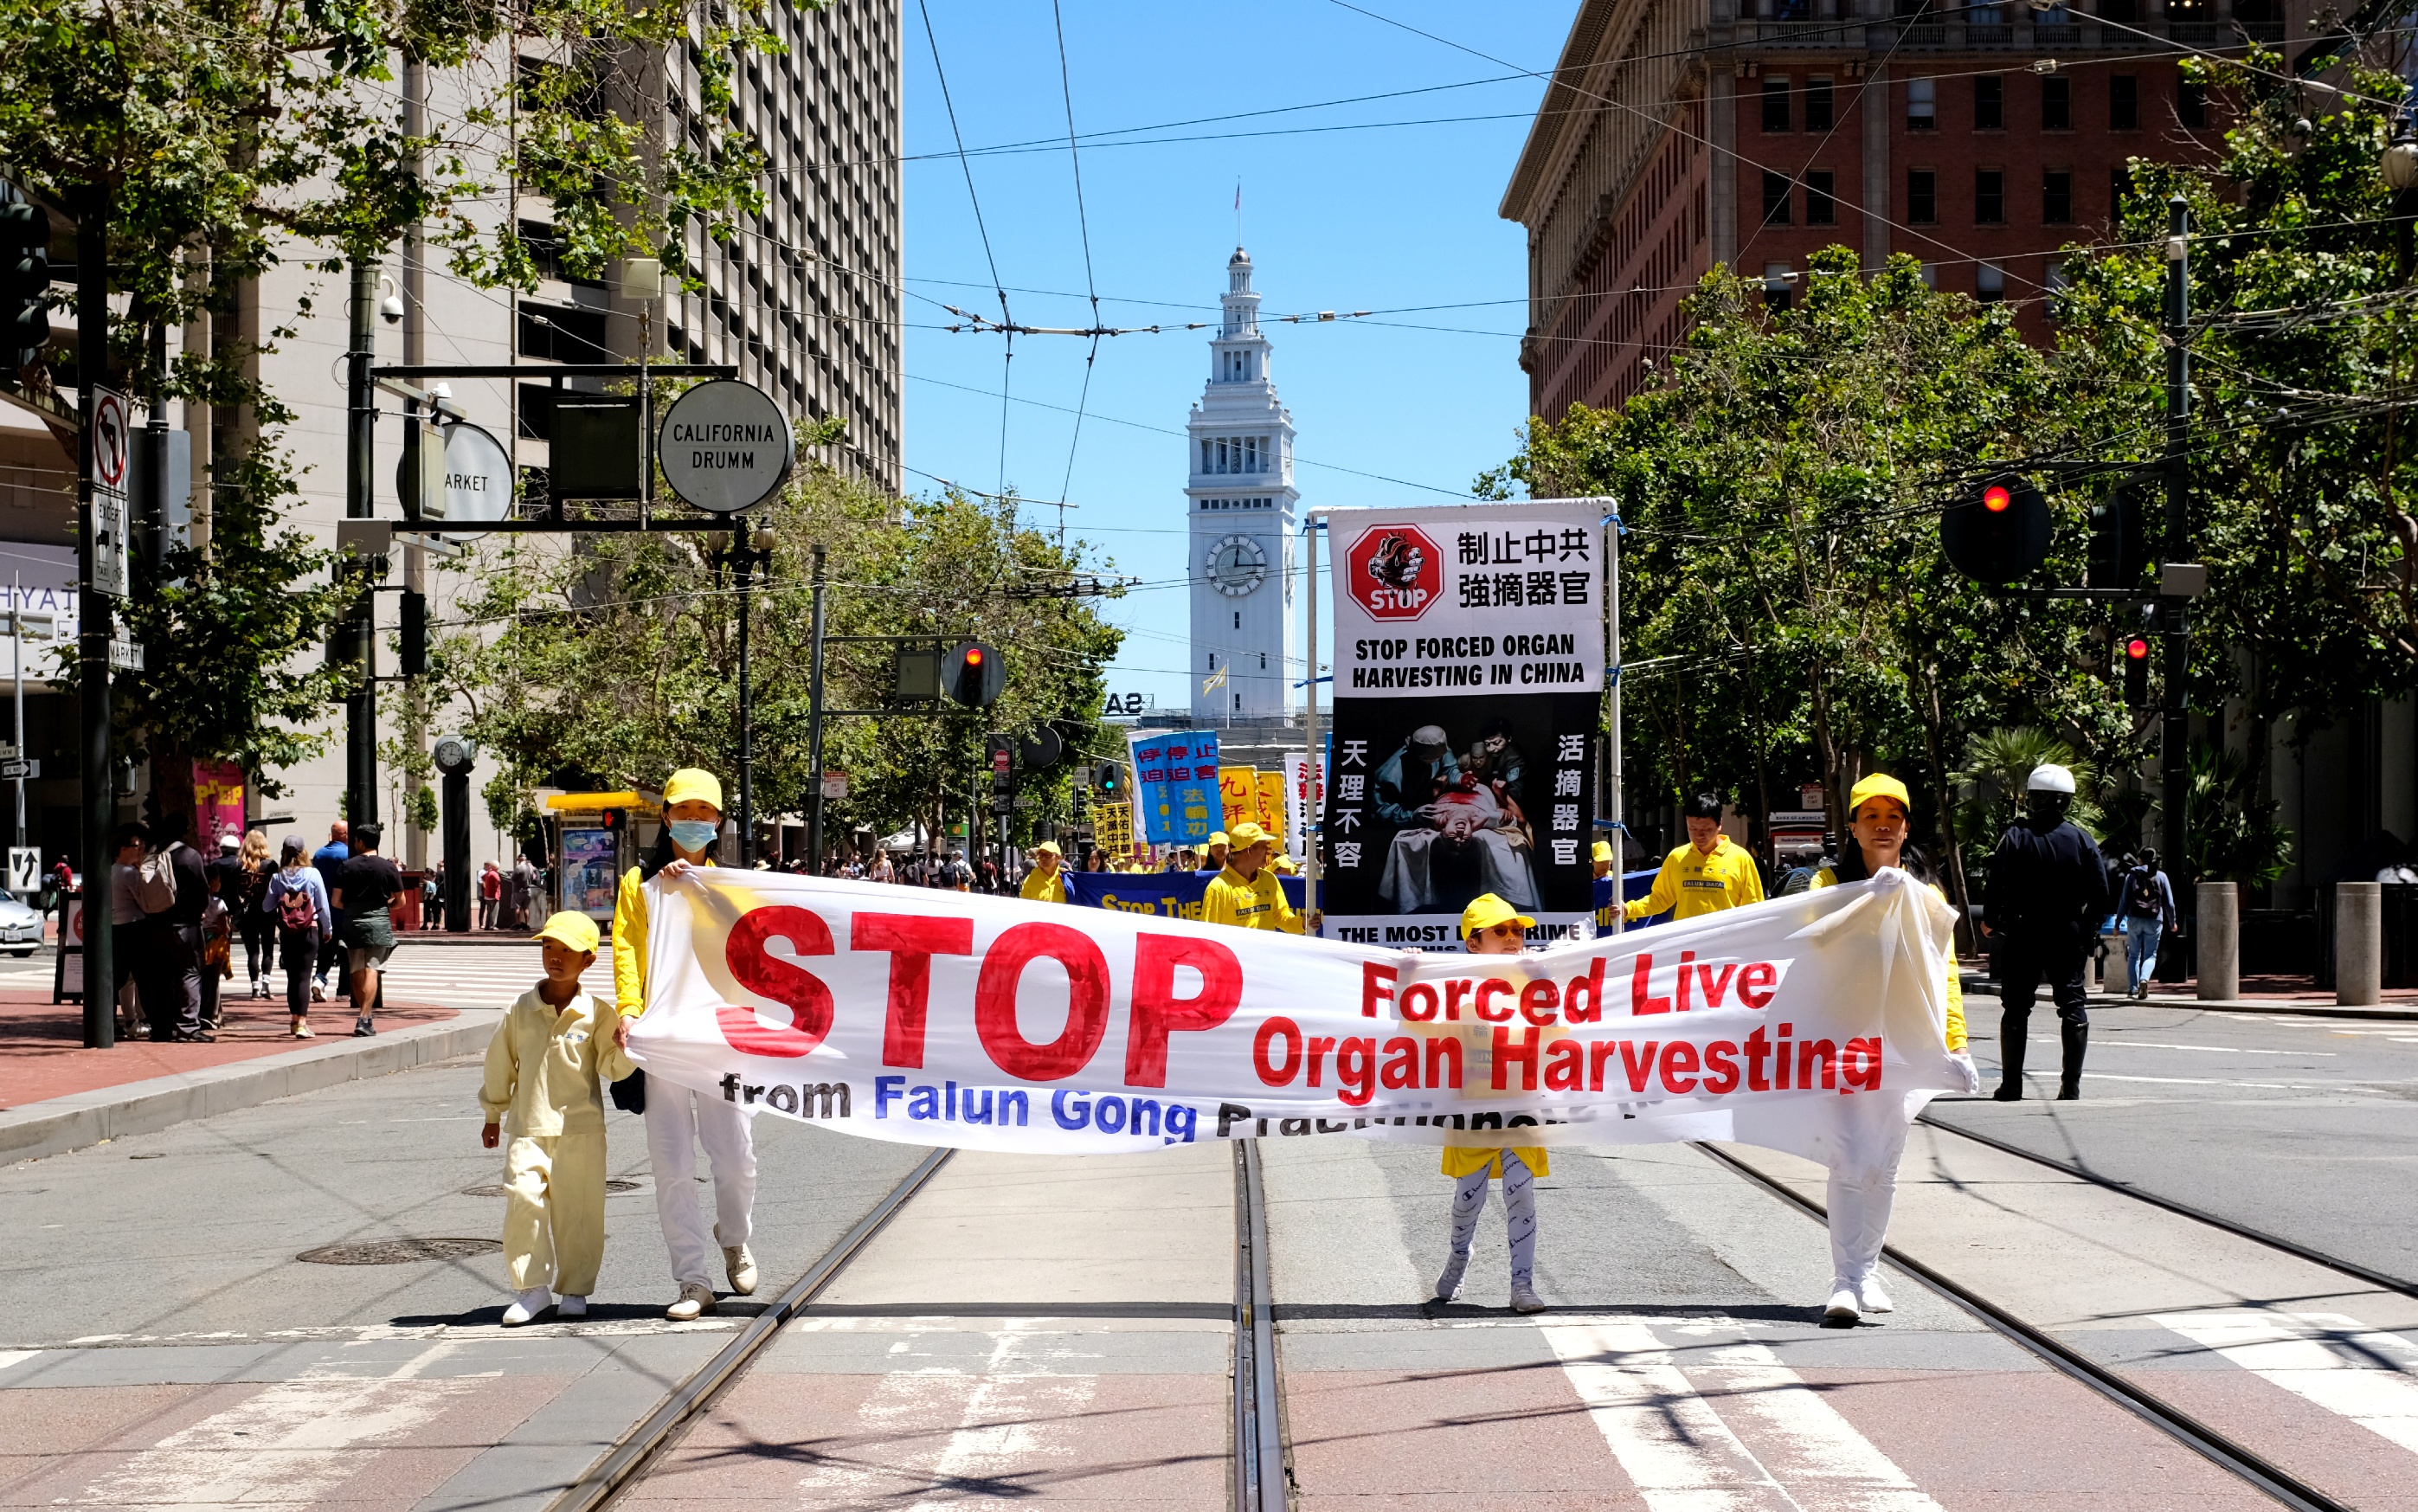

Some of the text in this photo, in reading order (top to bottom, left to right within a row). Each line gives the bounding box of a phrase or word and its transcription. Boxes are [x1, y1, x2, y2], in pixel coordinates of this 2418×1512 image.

[673, 424, 775, 442] CALIFORNIA
[692, 451, 754, 469] DRUMM
[445, 475, 488, 492] ARKET
[99, 504, 122, 524] EXCEPT
[1457, 528, 1590, 565] 制止中共
[97, 565, 108, 577] TAXI
[0, 585, 78, 611] HYAT
[1371, 589, 1427, 609] STOP
[1459, 570, 1591, 608] 強摘器官
[110, 644, 138, 663] MARKET
[1356, 634, 1574, 660] STOP FORCED ORGAN
[1353, 662, 1585, 688] HARVESTING IN CHINA
[195, 780, 242, 805] PrEP
[1334, 740, 1367, 868] 天理不容
[1551, 734, 1584, 865] 活摘器官
[1338, 928, 1379, 943] THE
[1386, 925, 1449, 943] MOST
[1525, 924, 1580, 941] RIME
[716, 905, 1243, 1089] STOP
[1361, 950, 1776, 1025] Forced Live
[1253, 1016, 1883, 1107] Organ Harvesting
[719, 1072, 852, 1120] from
[875, 1075, 1029, 1127] Falun
[1051, 1089, 1197, 1144] Gong
